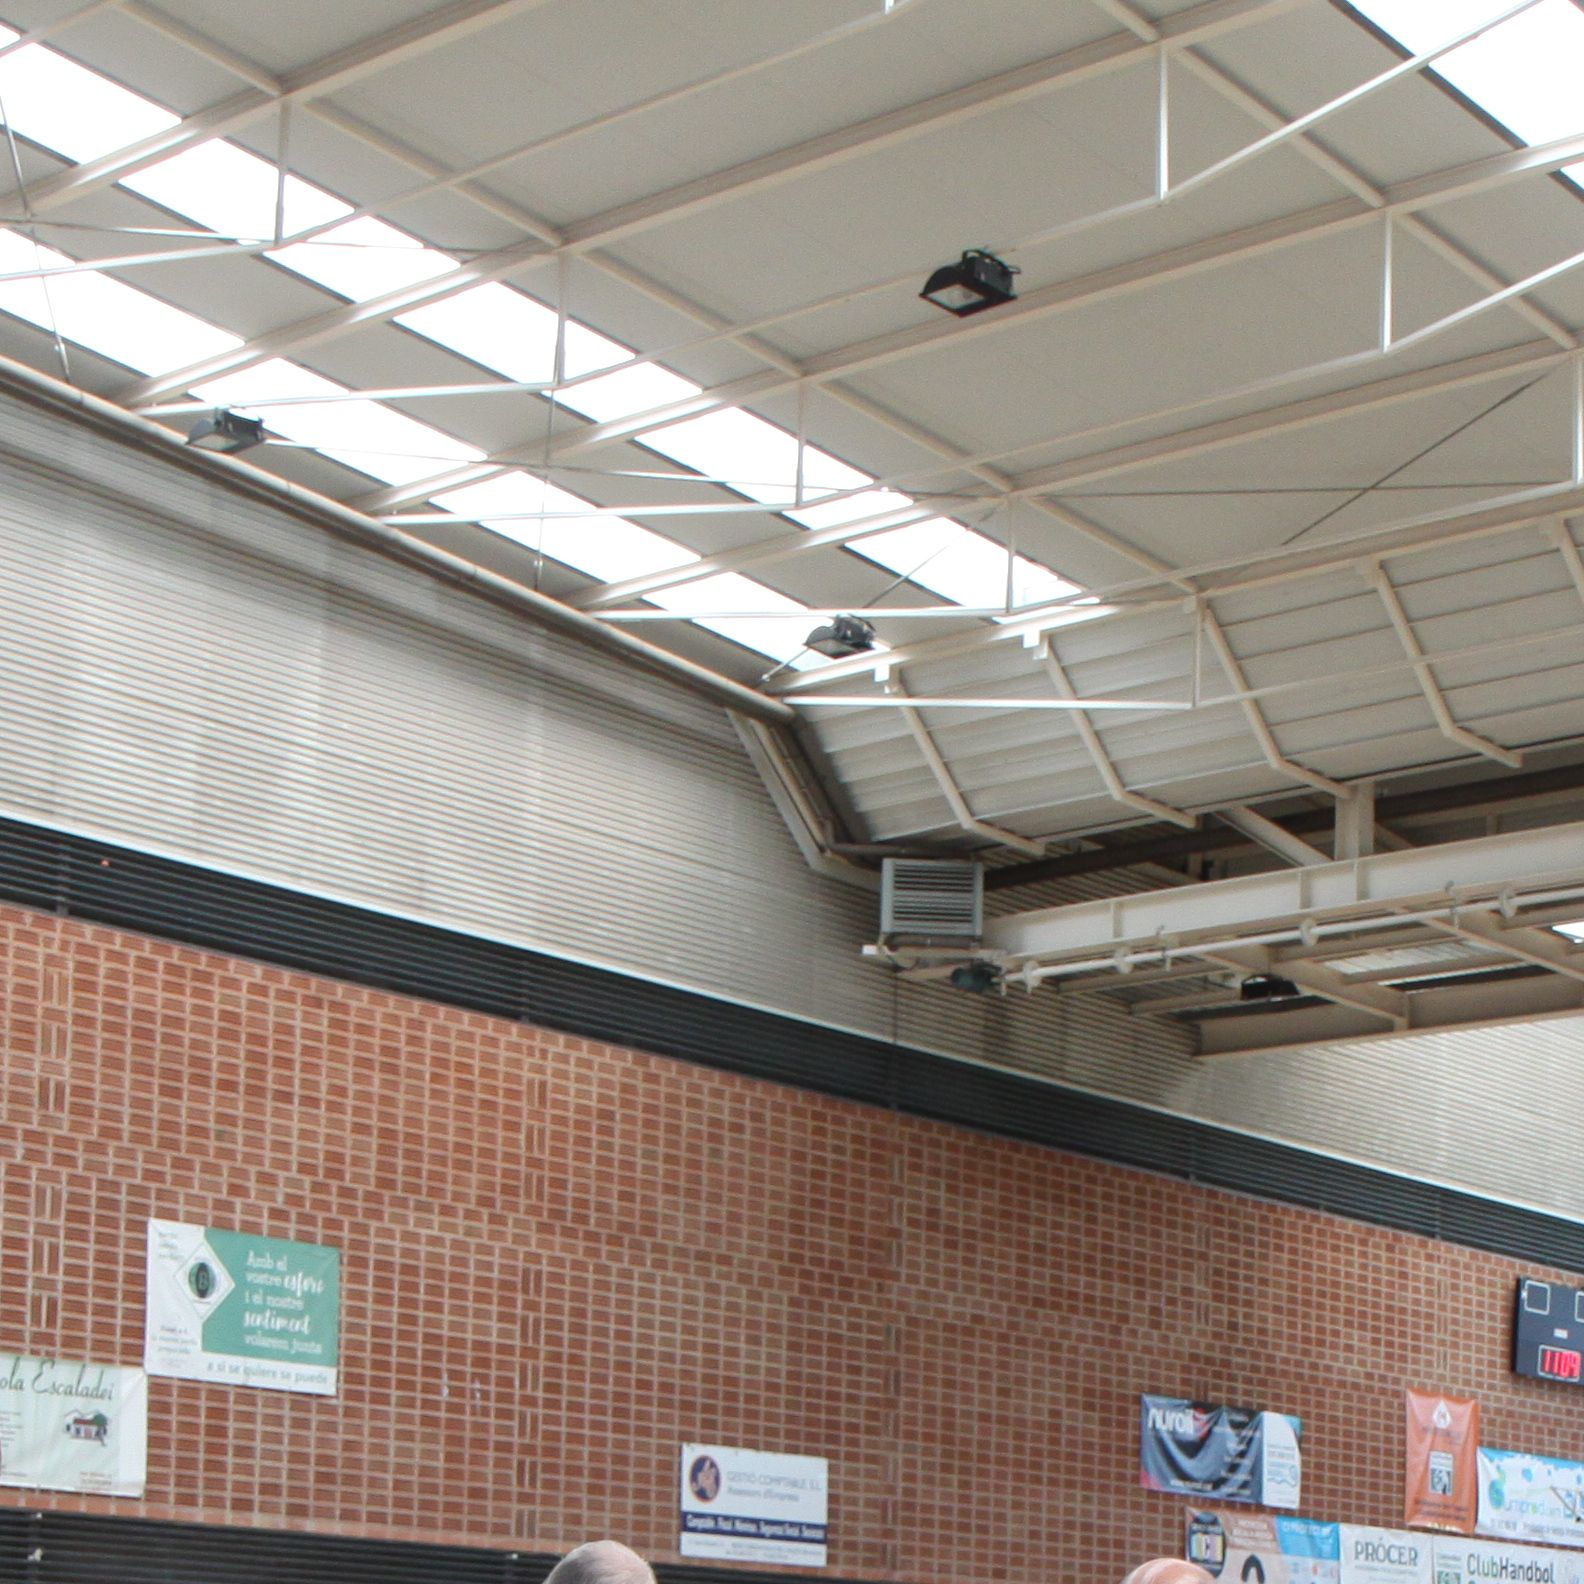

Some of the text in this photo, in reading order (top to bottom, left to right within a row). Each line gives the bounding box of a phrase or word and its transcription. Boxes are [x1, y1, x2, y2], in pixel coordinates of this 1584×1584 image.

[246, 1250, 274, 1269] Amb
[243, 1309, 311, 1335] sentiment
[1354, 1537, 1418, 1566] PRÓCER
